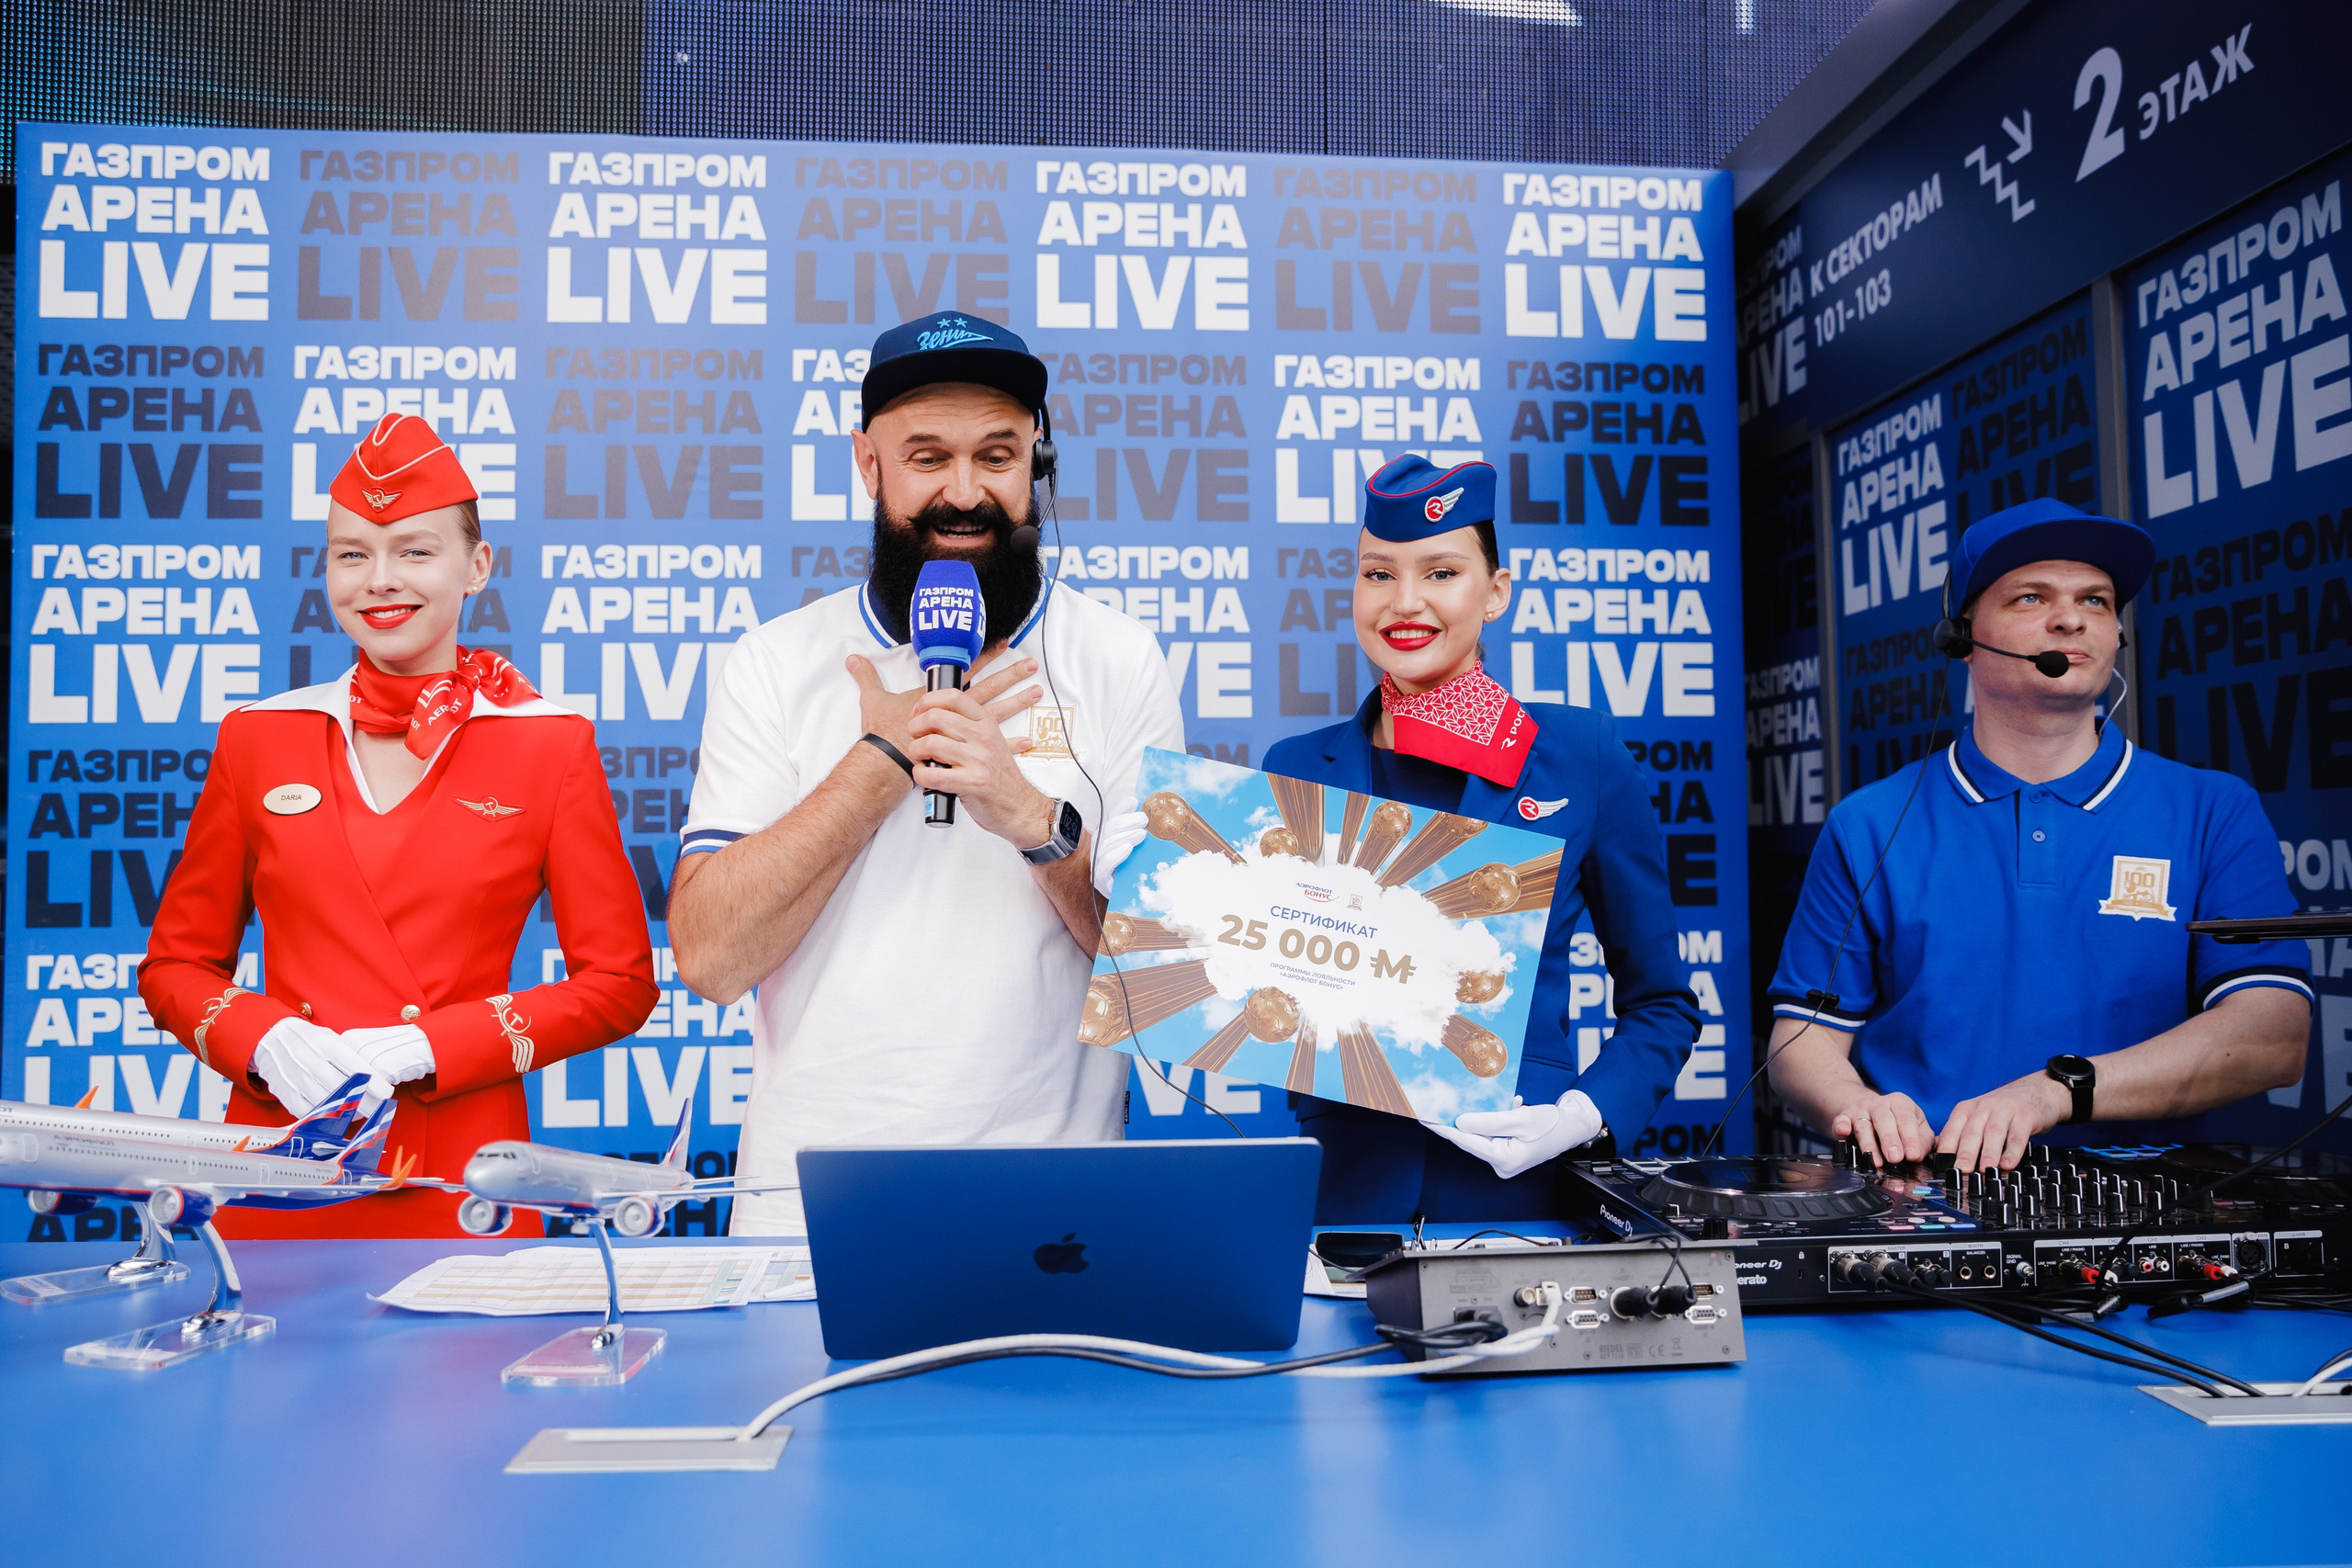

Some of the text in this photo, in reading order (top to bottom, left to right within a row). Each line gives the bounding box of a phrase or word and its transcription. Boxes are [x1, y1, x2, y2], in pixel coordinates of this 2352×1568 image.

[2073, 23, 2255, 183] 2 ЭТАЖ
[41, 141, 270, 181] ГАЗПРОМ
[300, 150, 520, 185] ГАЗПРОМ
[549, 152, 767, 187] ГАЗПРОМ
[795, 157, 1009, 192] ГАЗПРОМ
[1035, 160, 1247, 198] ГАЗПРОМ
[40, 184, 270, 235] АРЕНА
[1274, 167, 1477, 204] ГАЗПРОМ
[1503, 172, 1702, 212] ГАЗПРОМ
[300, 191, 519, 237] АРЕНА
[548, 192, 767, 241] АРЕНА
[796, 197, 1009, 243] АРЕНА
[1036, 200, 1248, 250] АРЕНА
[1275, 207, 1478, 254] АРЕНА
[1505, 211, 1703, 262] АРЕНА
[1810, 172, 1943, 298] К СЕКТОРАМ
[2137, 180, 2342, 328] ГАЗПРОМ
[39, 240, 270, 321] LIVE
[298, 246, 519, 321] LIVE
[547, 246, 768, 325] LIVE
[794, 251, 1010, 326] LIVE
[1035, 253, 1250, 332] LIVE
[1275, 259, 1481, 335] LIVE
[1505, 263, 1707, 342] LIVE
[1814, 268, 1892, 347] 101-103
[2143, 253, 2347, 402] АРЕНА
[38, 344, 265, 378] ГАЗПРОМ
[294, 345, 516, 381] ГАЗПРОМ
[546, 347, 763, 381] ГАЗПРОМ
[1273, 355, 1480, 391] ГАЗПРОМ
[1508, 360, 1704, 395] ГАЗПРОМ
[1952, 316, 2086, 421] ГАЗПРОМ
[39, 387, 264, 433] АРЕНА
[547, 389, 763, 435] АРЕНА
[1275, 395, 1483, 444] АРЕНА
[1510, 400, 1706, 446] АРЕНА
[1956, 374, 2090, 480] АРЕНА
[2143, 333, 2352, 521] LIVE
[1838, 392, 1943, 477] ГАЗПРОМ
[35, 443, 264, 520] LIVE
[544, 446, 763, 521] LIVE
[1510, 453, 1710, 526] LIVE
[1840, 441, 1946, 531] АРЕНА
[30, 545, 260, 581] ГАЗПРОМ
[541, 545, 762, 579] ГАЗПРОМ
[1510, 548, 1710, 583] ГАЗПРОМ
[1841, 499, 1951, 617] LIVE
[2152, 506, 2352, 607] ГАЗПРОМ
[30, 587, 260, 636] АРЕНА
[540, 586, 761, 635] АРЕНА
[919, 587, 974, 597] ГАЗПРОМ
[919, 596, 974, 610] АРЕНА
[1511, 589, 1712, 635] АРЕНА
[919, 609, 973, 632] LIVE
[28, 643, 260, 724] LIVE
[1511, 642, 1715, 717] LIVE
[28, 750, 212, 783] ГАЗПРО
[1295, 882, 1333, 894] АЭРОФЛОТ
[1304, 889, 1332, 901] БОНУС
[1216, 914, 1269, 951] 25
[1279, 928, 1361, 972] 000
[1270, 905, 1378, 939] СЕРТИФИКАТ
[1270, 962, 1356, 987] ПРОГРАММЫ ЛОЯЛЬНОСТИ
[1600, 1204, 1624, 1230] Pioneer
[1736, 1273, 1768, 1286] erato
